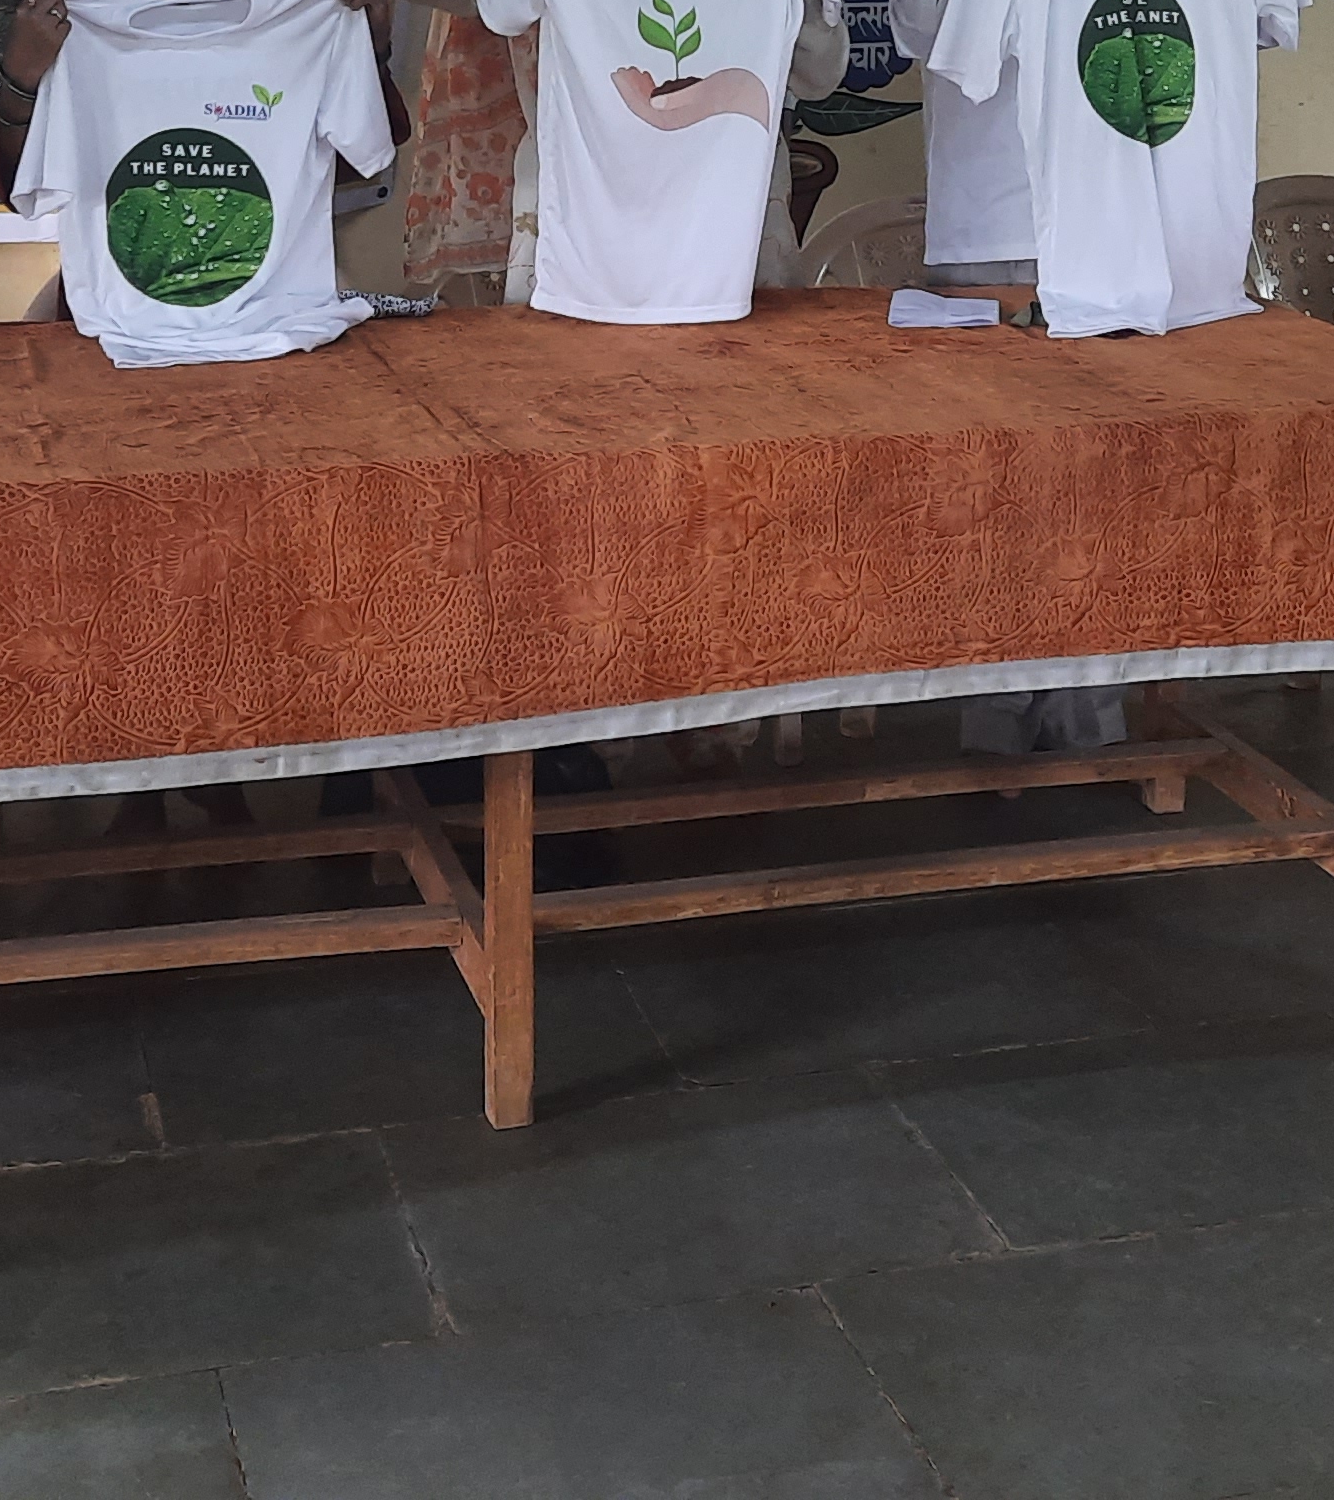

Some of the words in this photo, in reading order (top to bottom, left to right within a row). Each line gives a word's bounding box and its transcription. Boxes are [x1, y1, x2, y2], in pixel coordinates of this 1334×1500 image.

[1094, 10, 1133, 29] THE
[1134, 10, 1180, 24] ANET
[161, 143, 213, 157] SAVE
[130, 161, 167, 175] THE
[173, 163, 251, 177] PLANET
